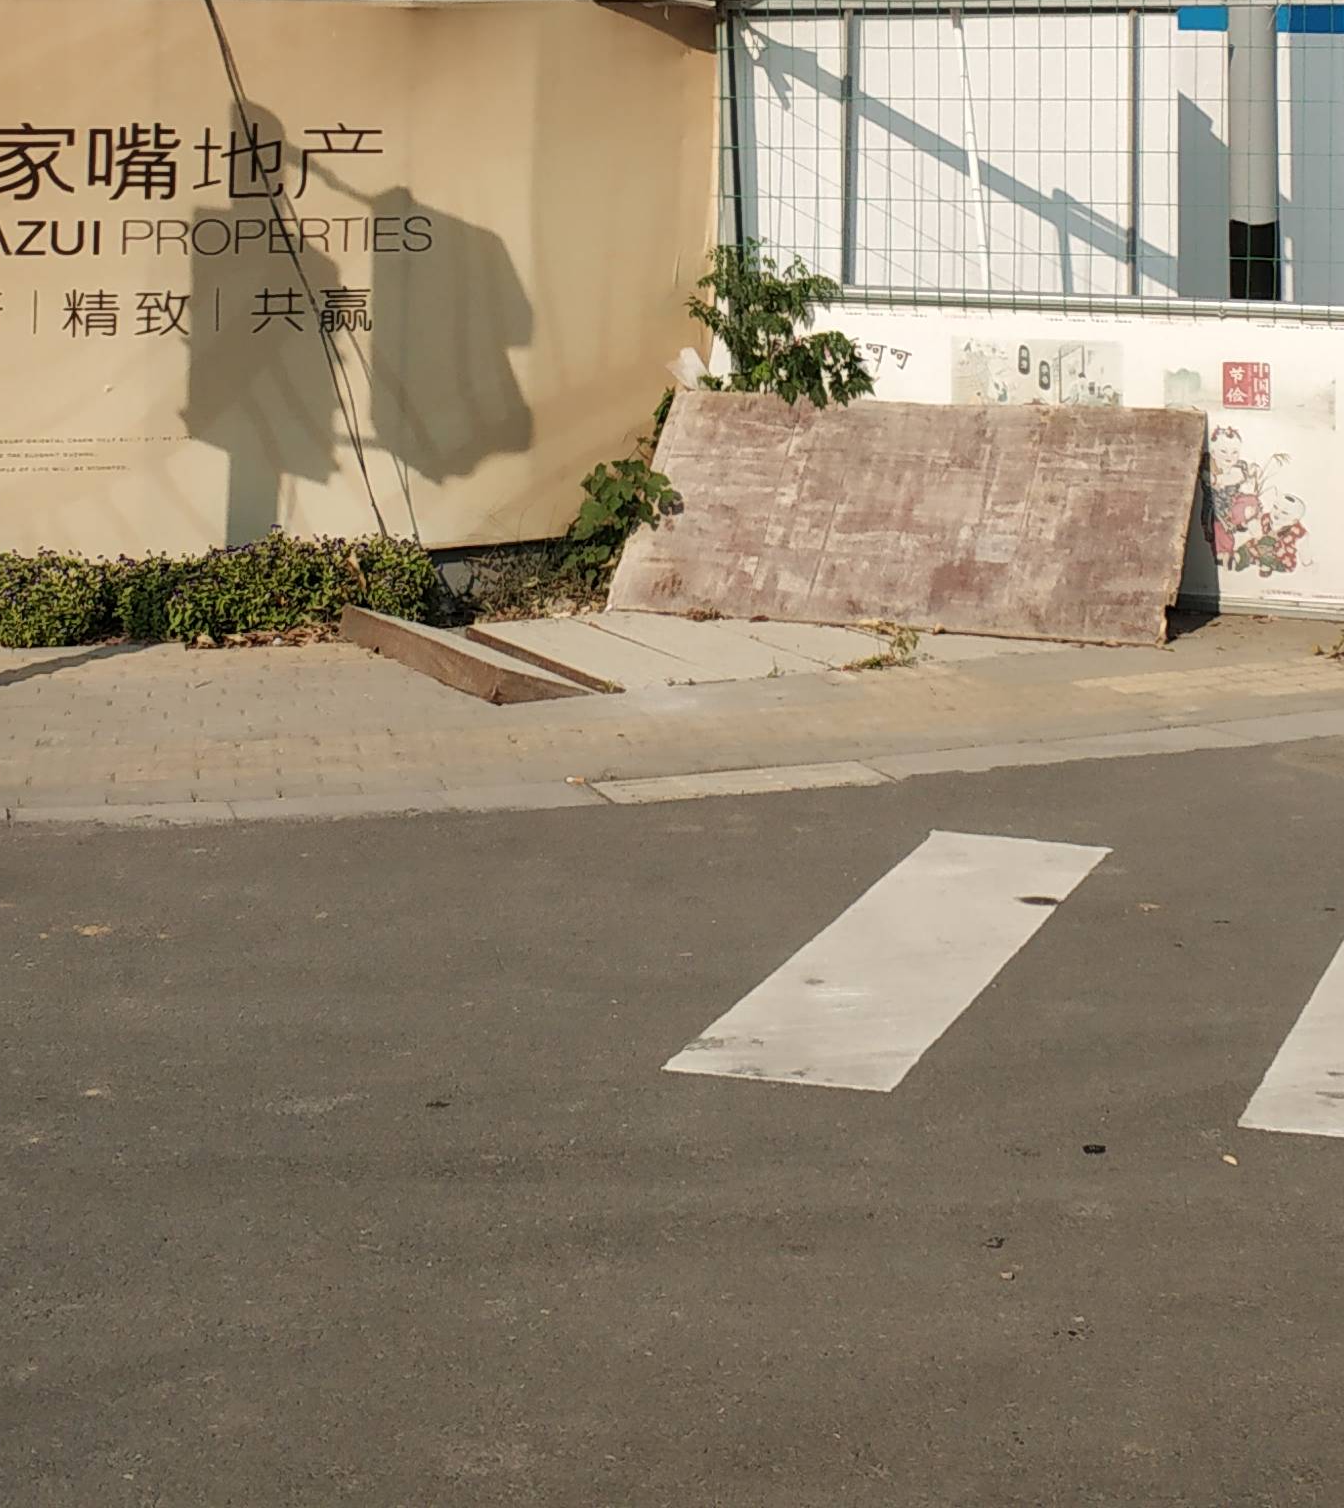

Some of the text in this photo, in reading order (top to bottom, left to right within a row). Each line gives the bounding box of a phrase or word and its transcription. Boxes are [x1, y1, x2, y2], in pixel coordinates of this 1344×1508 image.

[120, 215, 435, 254] PROPERTIES
[62, 288, 191, 338] 精致
[250, 286, 375, 336] 共赢
[1226, 366, 1248, 404] 节俭
[1253, 361, 1270, 410] 中国梦
